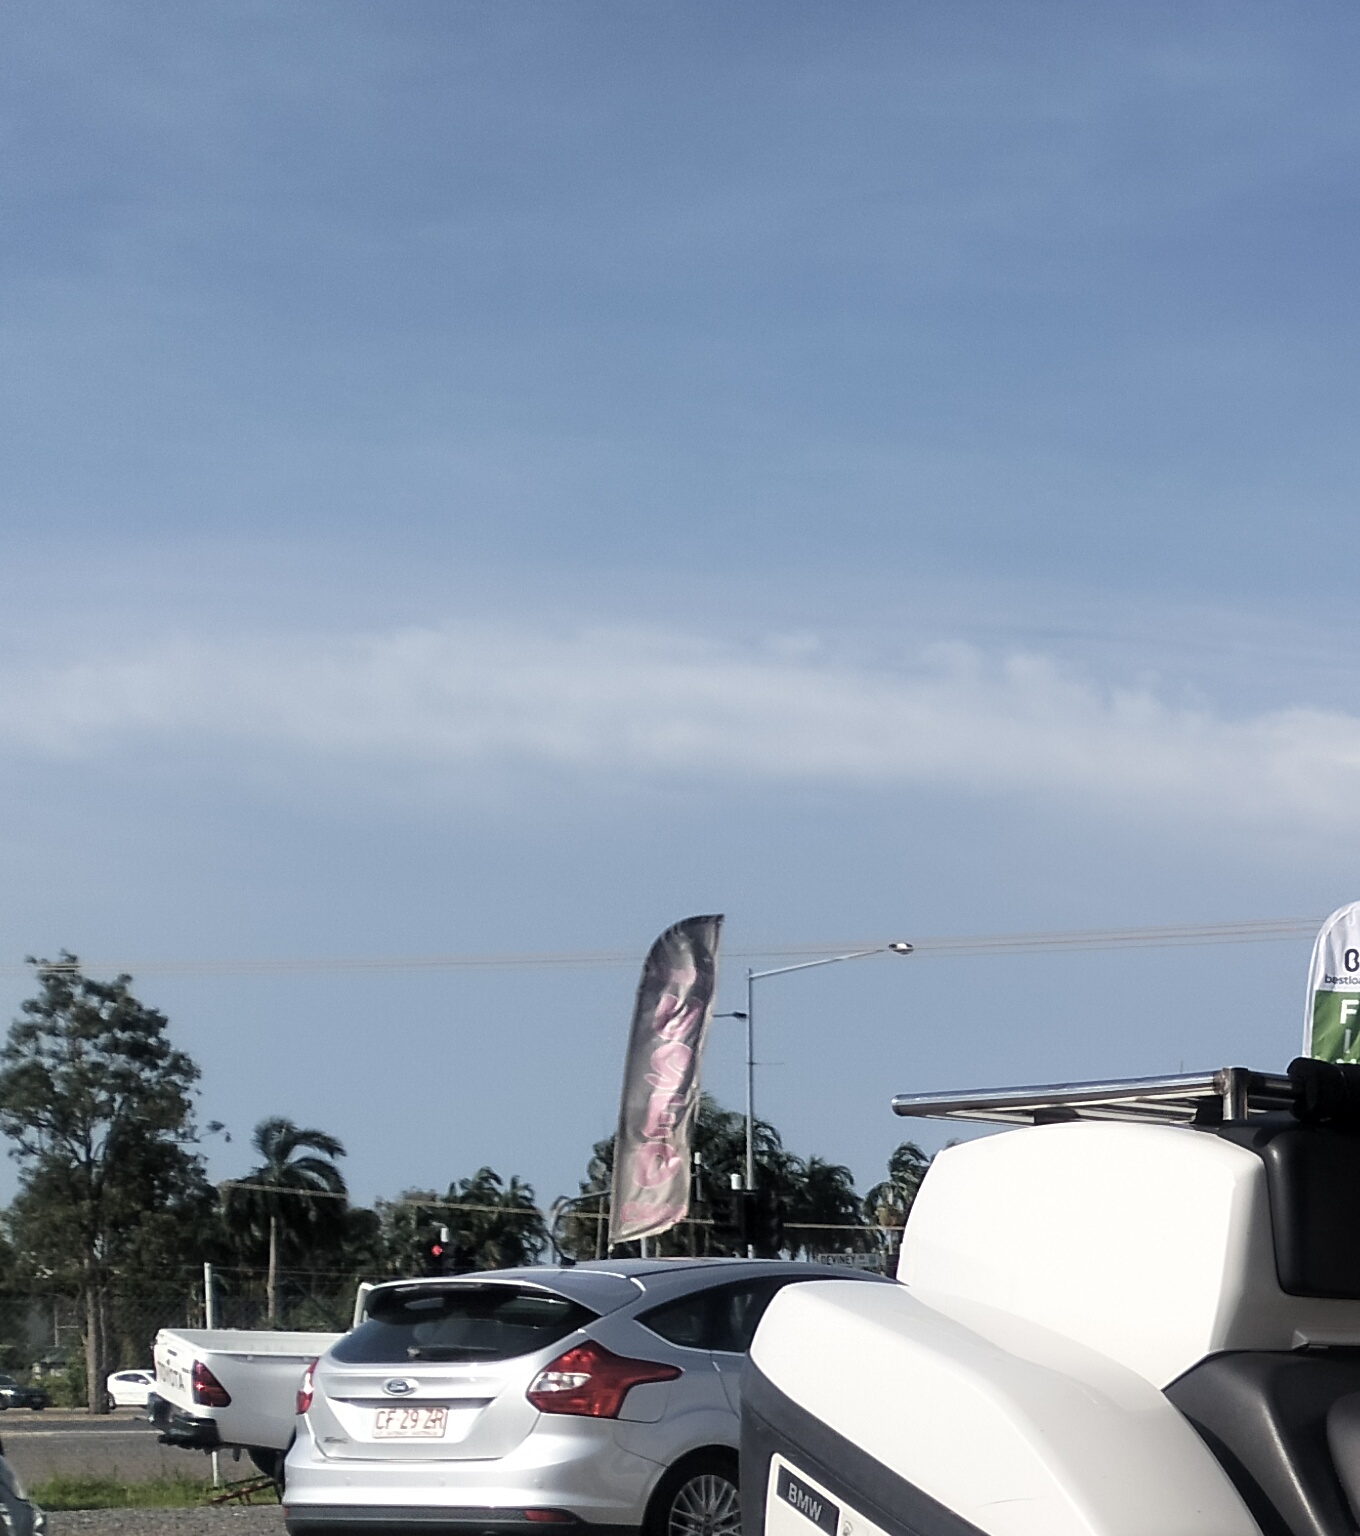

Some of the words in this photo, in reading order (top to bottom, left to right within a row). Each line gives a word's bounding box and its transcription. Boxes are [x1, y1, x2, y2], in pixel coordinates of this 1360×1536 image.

[1336, 999, 1360, 1064] FI
[375, 1410, 397, 1430] CF
[399, 1410, 419, 1430] 29
[788, 1482, 822, 1521] BMW
